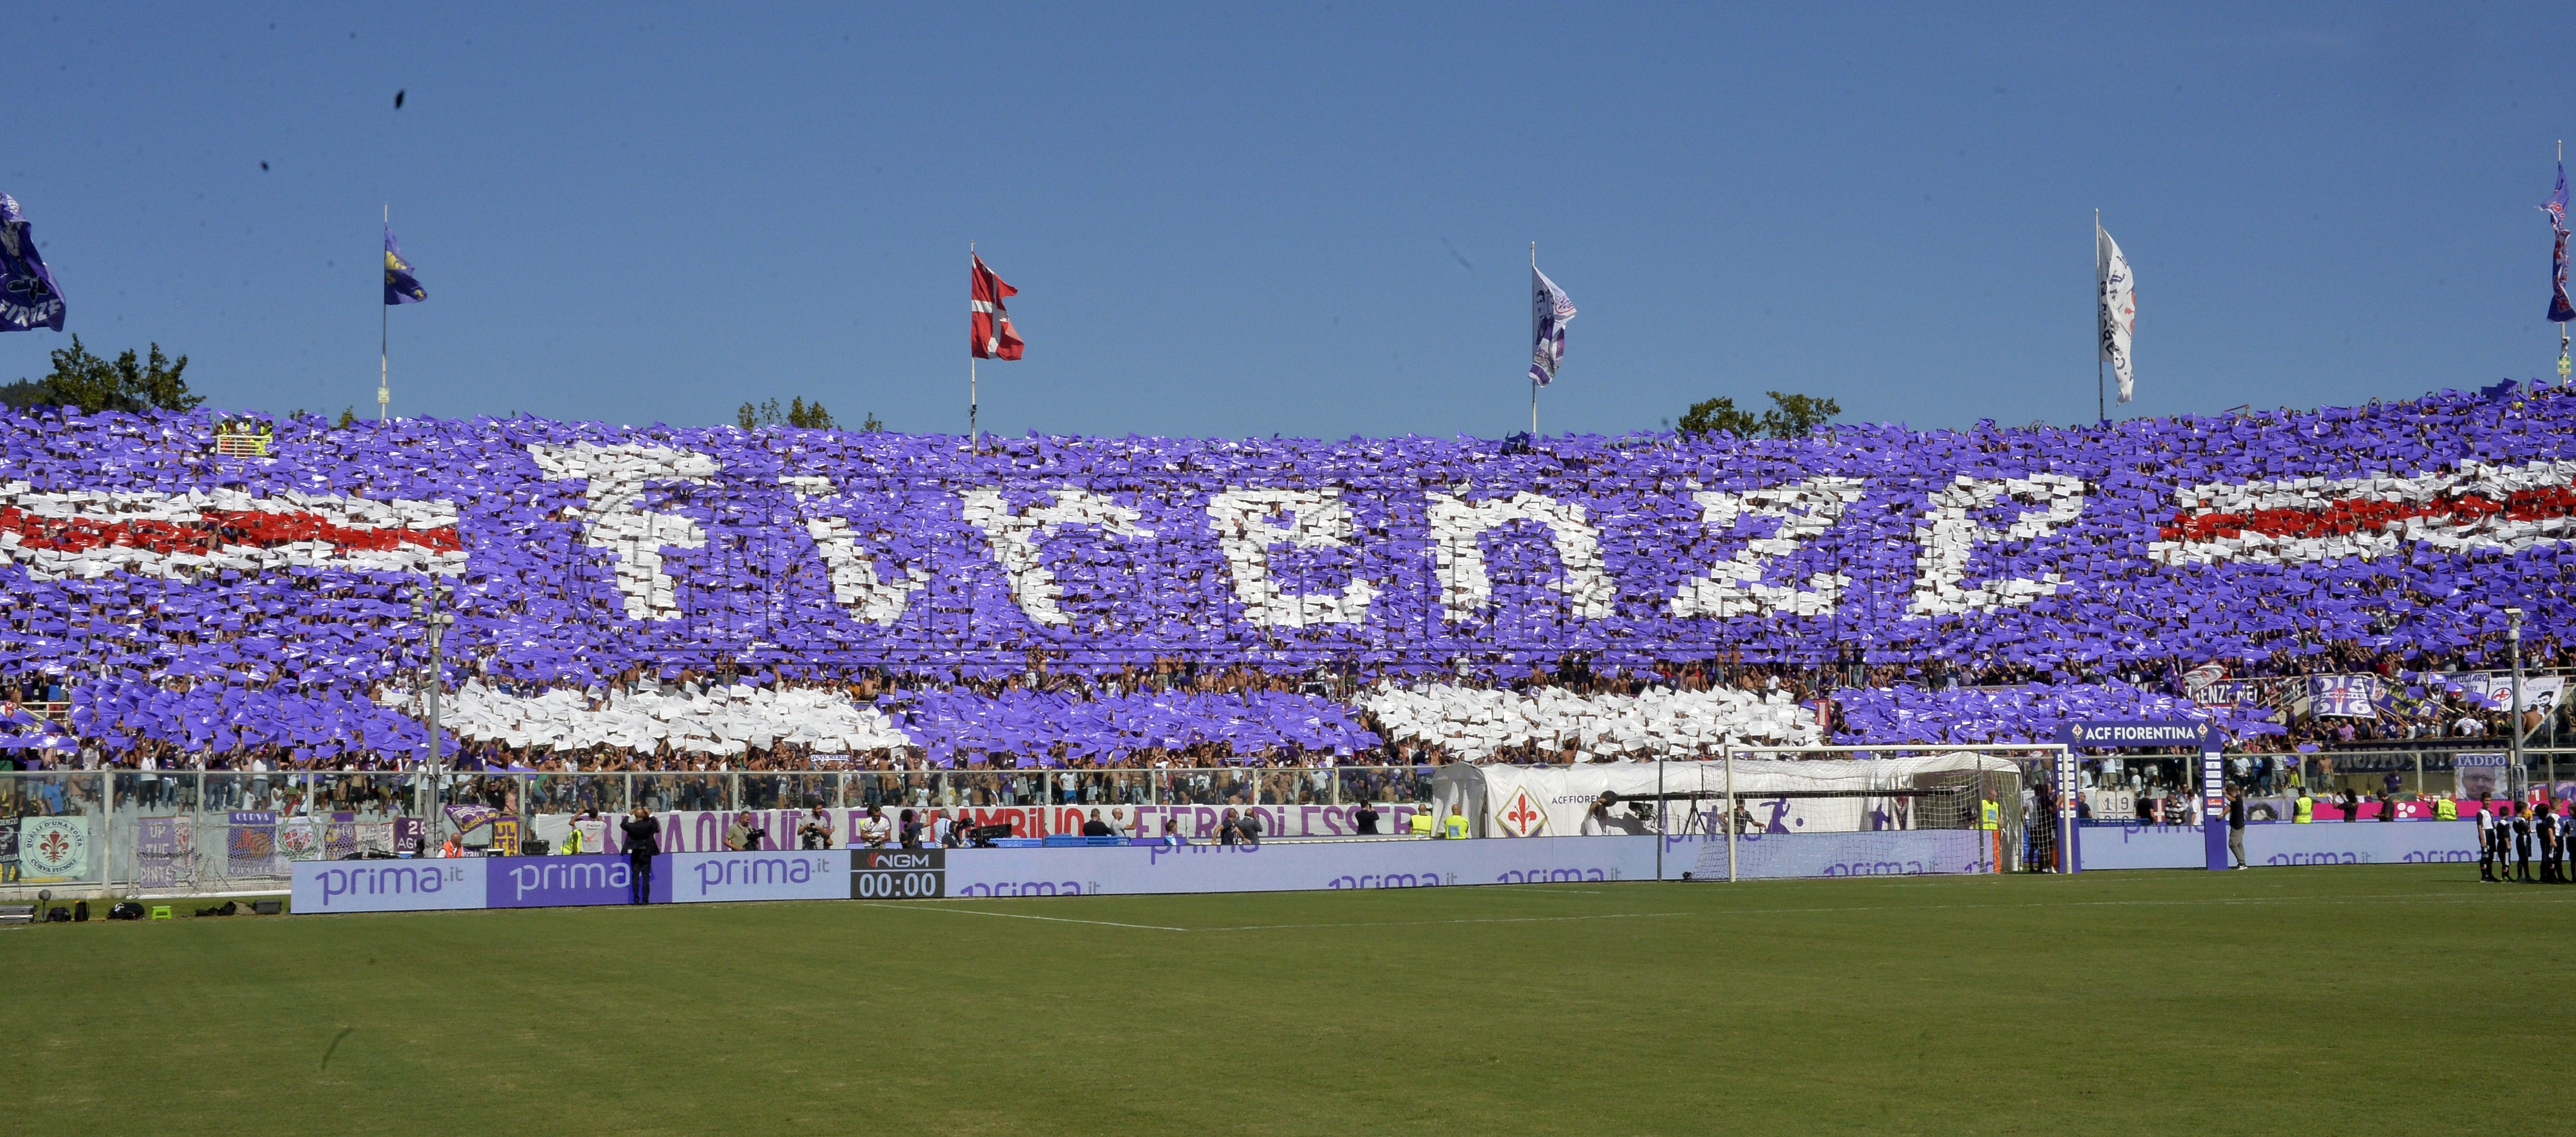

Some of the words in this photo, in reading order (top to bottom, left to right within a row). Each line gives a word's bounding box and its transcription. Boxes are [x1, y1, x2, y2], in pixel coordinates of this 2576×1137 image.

[2085, 727, 2112, 740] ACF
[2114, 726, 2195, 740] FIORENTINA
[2456, 756, 2506, 766] TADDO
[1551, 796, 1567, 805] ACF
[236, 813, 270, 821] CURVA
[70, 826, 83, 847] VOLTA
[150, 822, 166, 838] UP
[30, 858, 51, 873] CURVA
[875, 854, 929, 868] NGM
[859, 873, 937, 898] 00:00
